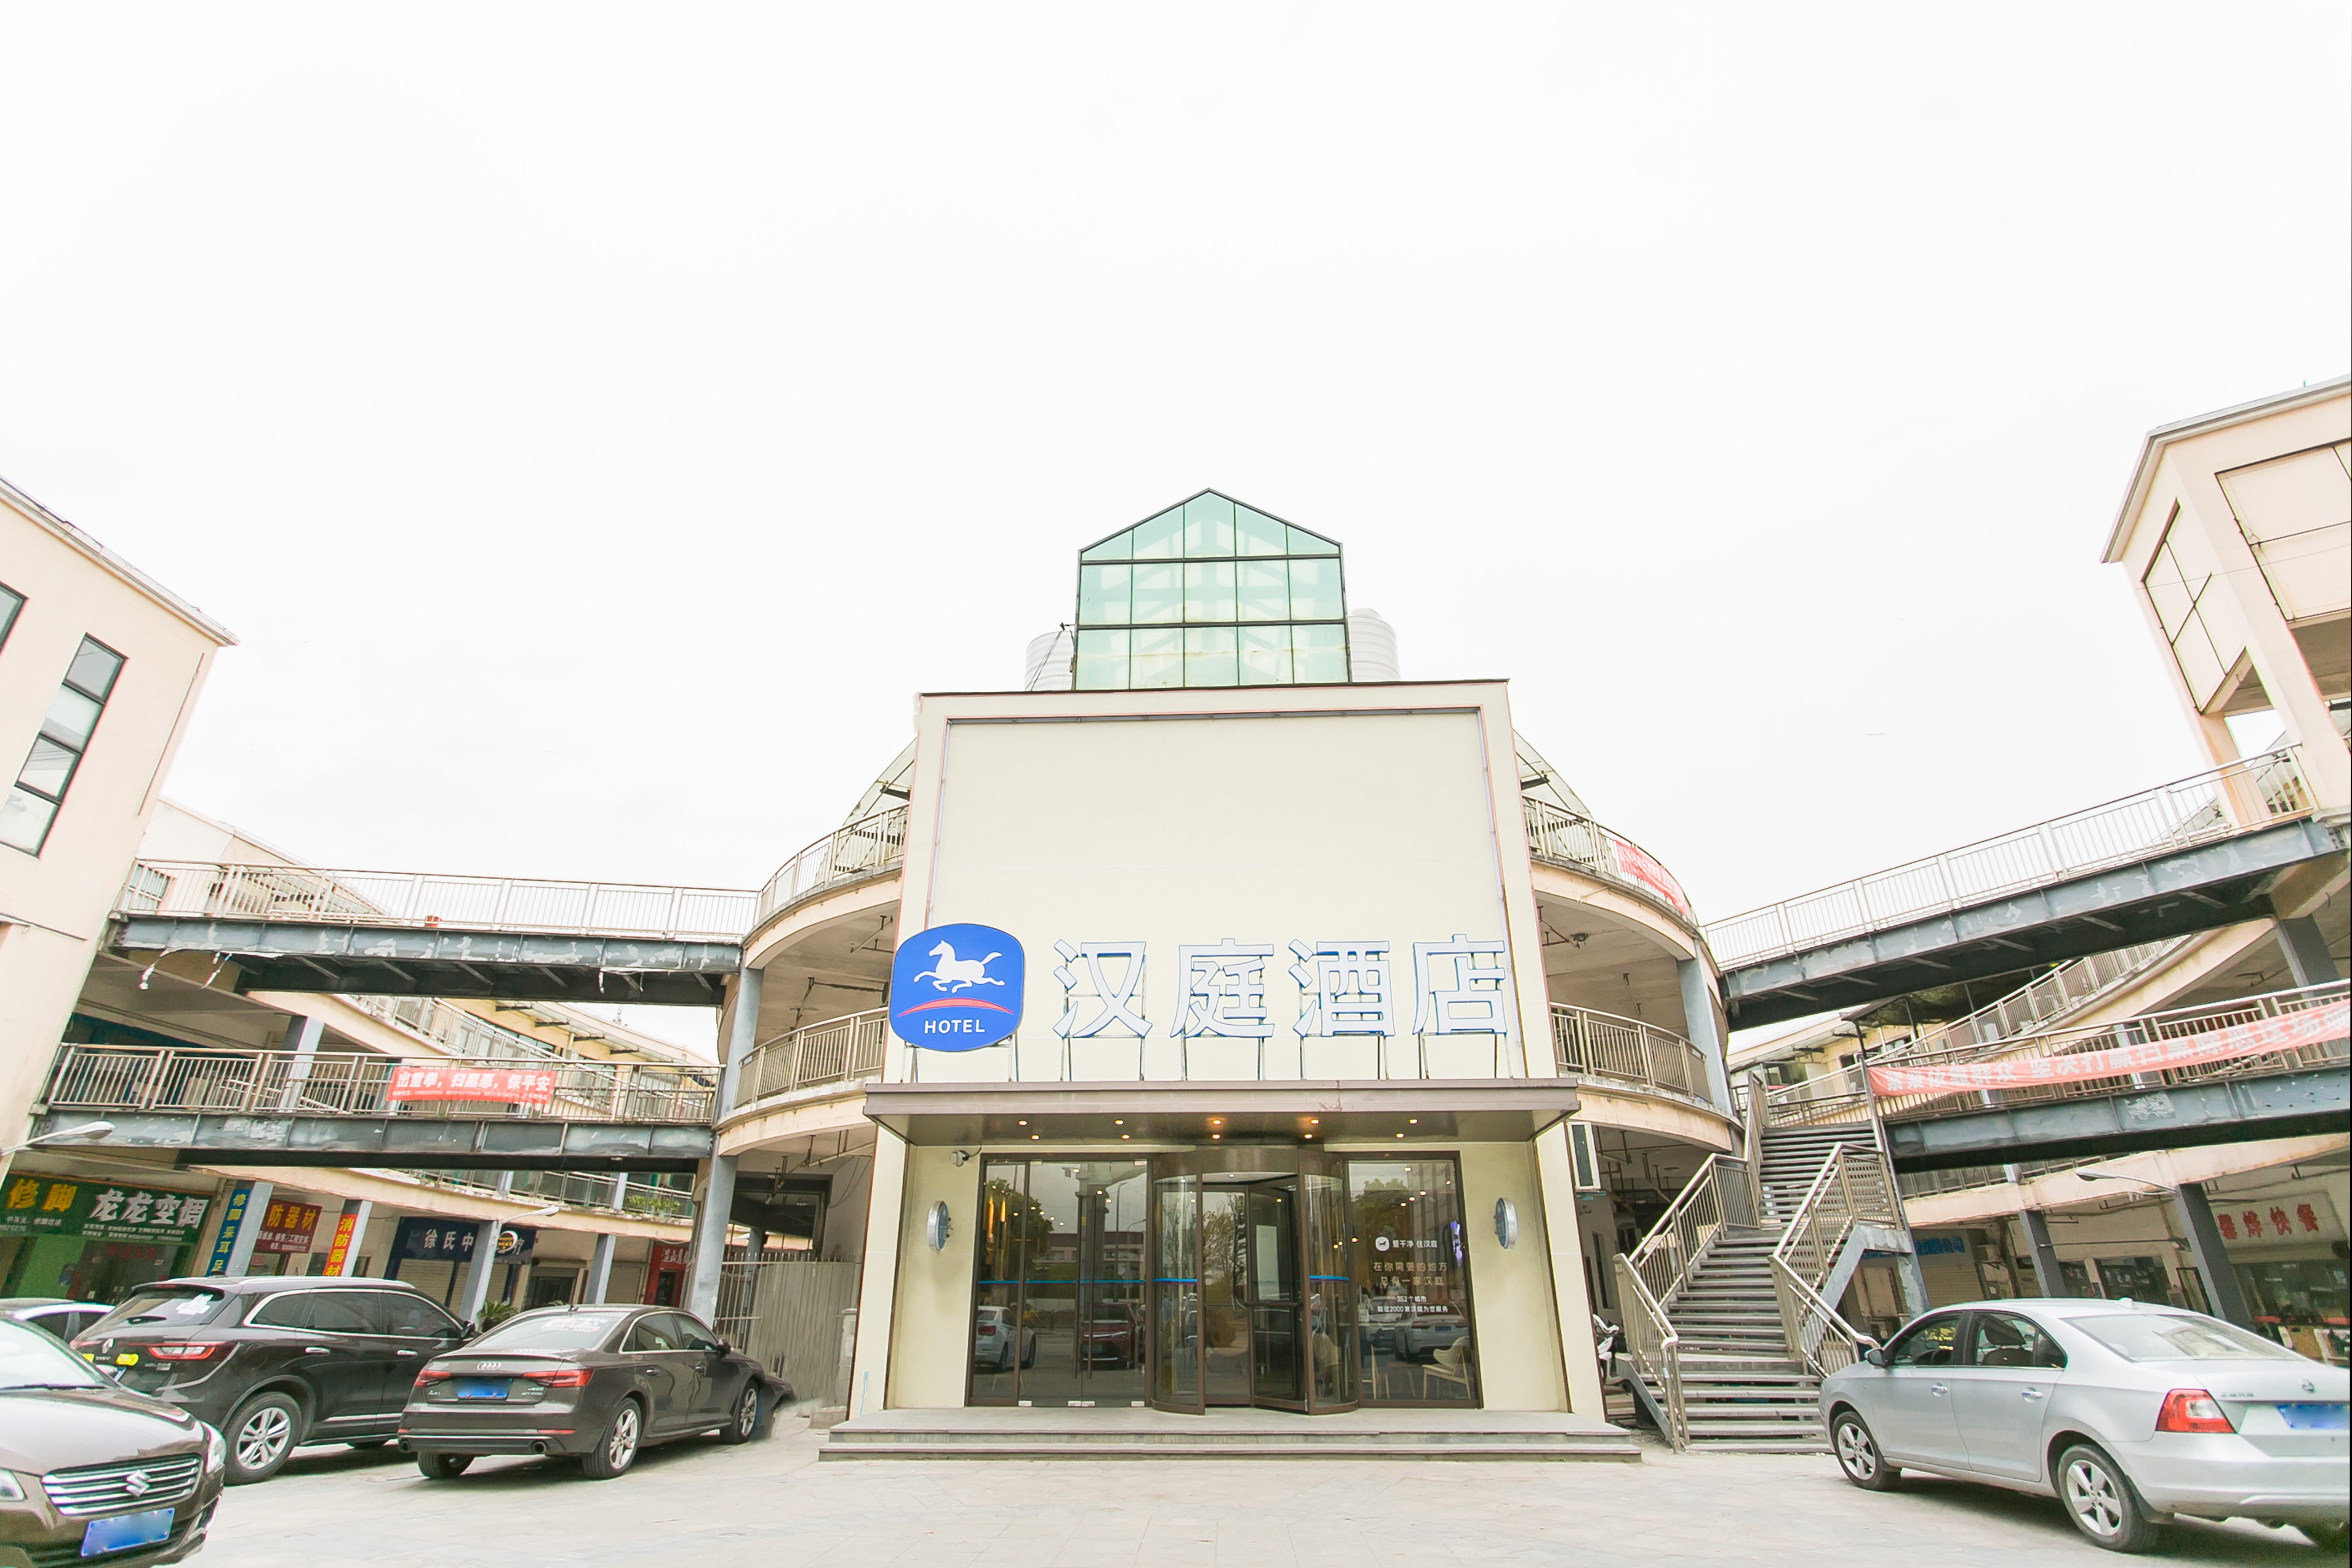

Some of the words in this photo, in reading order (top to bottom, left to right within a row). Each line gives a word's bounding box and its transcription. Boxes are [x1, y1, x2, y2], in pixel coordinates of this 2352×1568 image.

[1053, 934, 1508, 1039] 汉庭酒店
[924, 1019, 985, 1034] HOTEL
[267, 1204, 316, 1231] 防器材
[325, 1218, 355, 1276] 消防器材
[423, 1228, 475, 1252] 徐氏中
[1392, 1239, 1414, 1248] 爱干净
[1416, 1239, 1438, 1248] 住汉庭
[1373, 1262, 1447, 1272] 在你需要的地方
[1380, 1275, 1445, 1286] 总有一家汉庭
